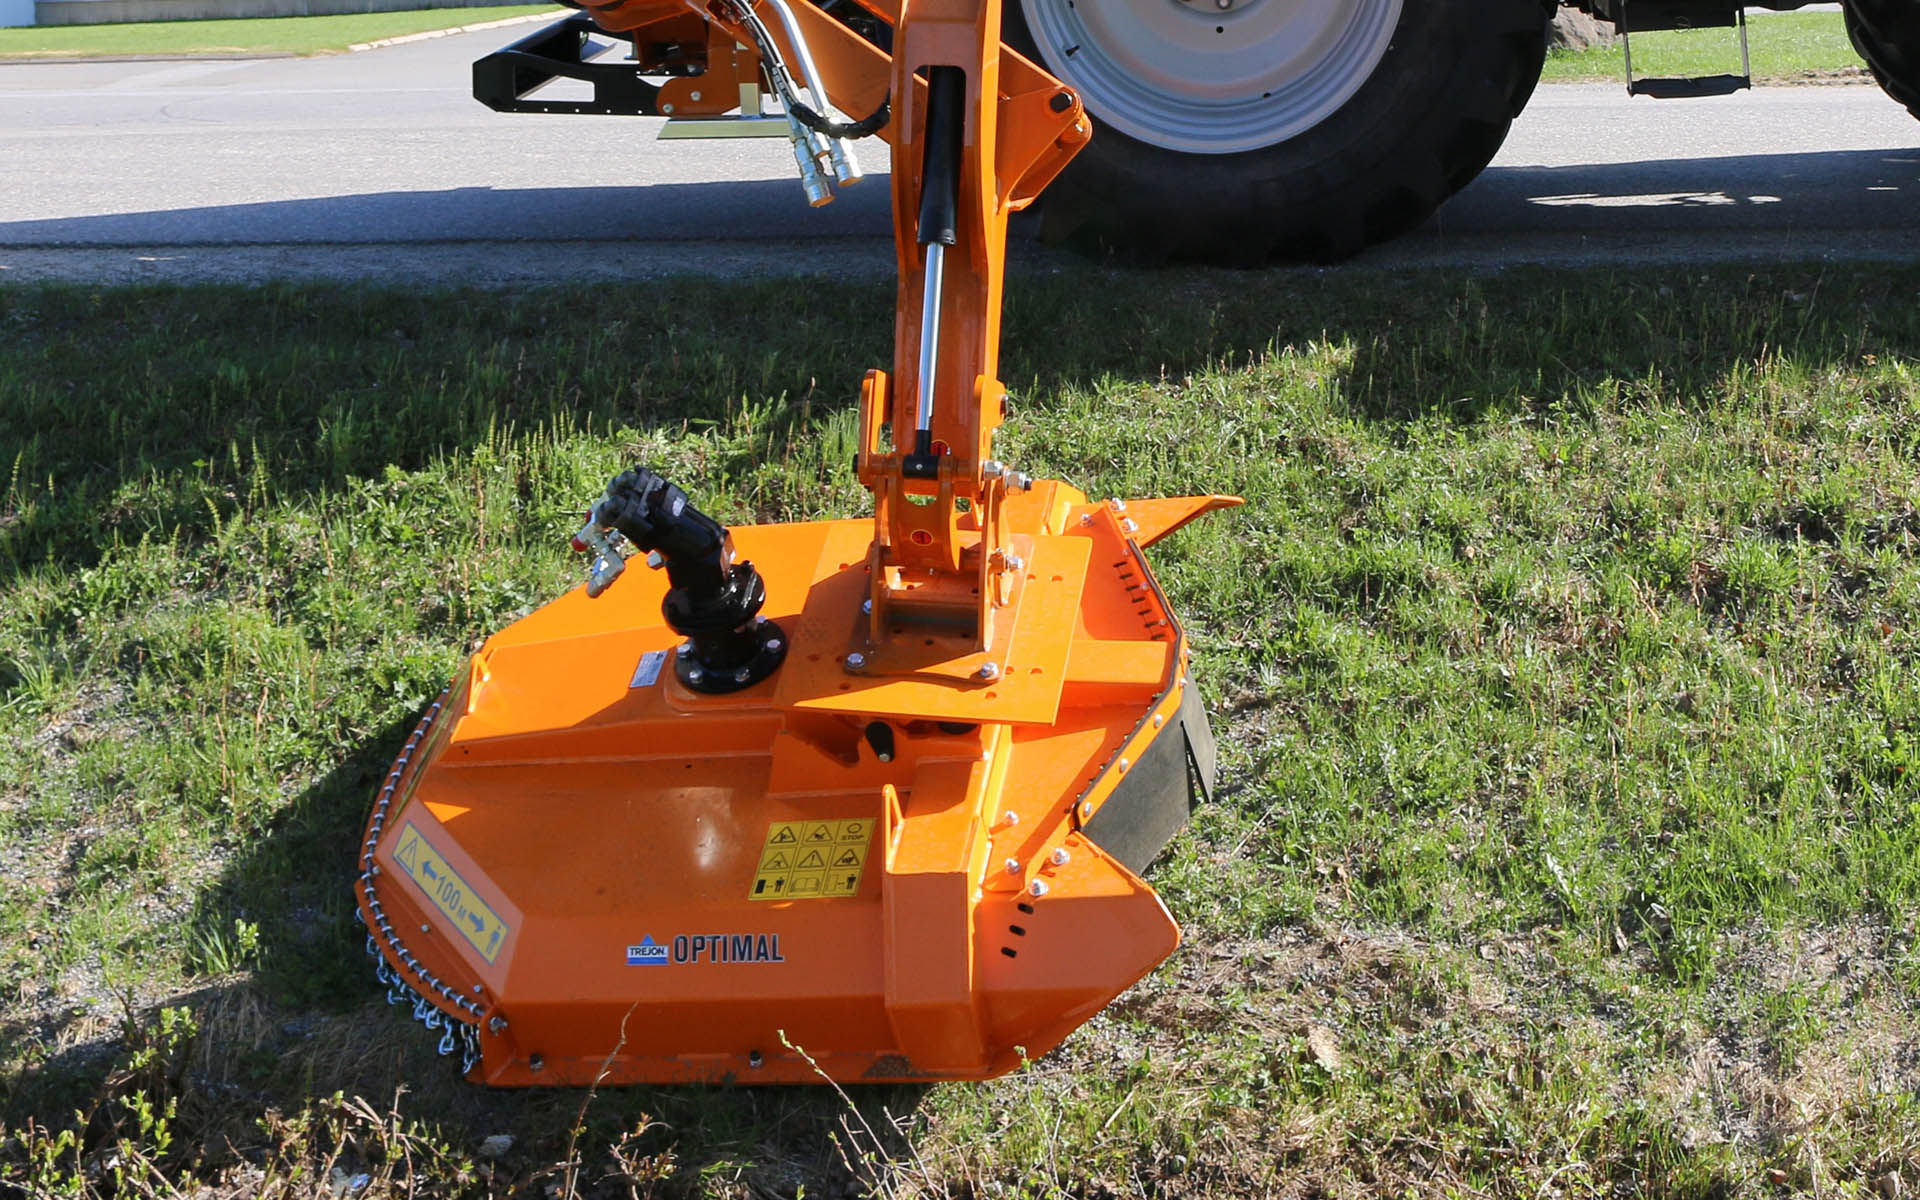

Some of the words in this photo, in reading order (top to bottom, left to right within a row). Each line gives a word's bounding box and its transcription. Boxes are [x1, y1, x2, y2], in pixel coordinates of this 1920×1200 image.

[436, 875, 461, 911] 100
[629, 947, 665, 956] TREJON
[674, 935, 784, 962] OPTIMAL
